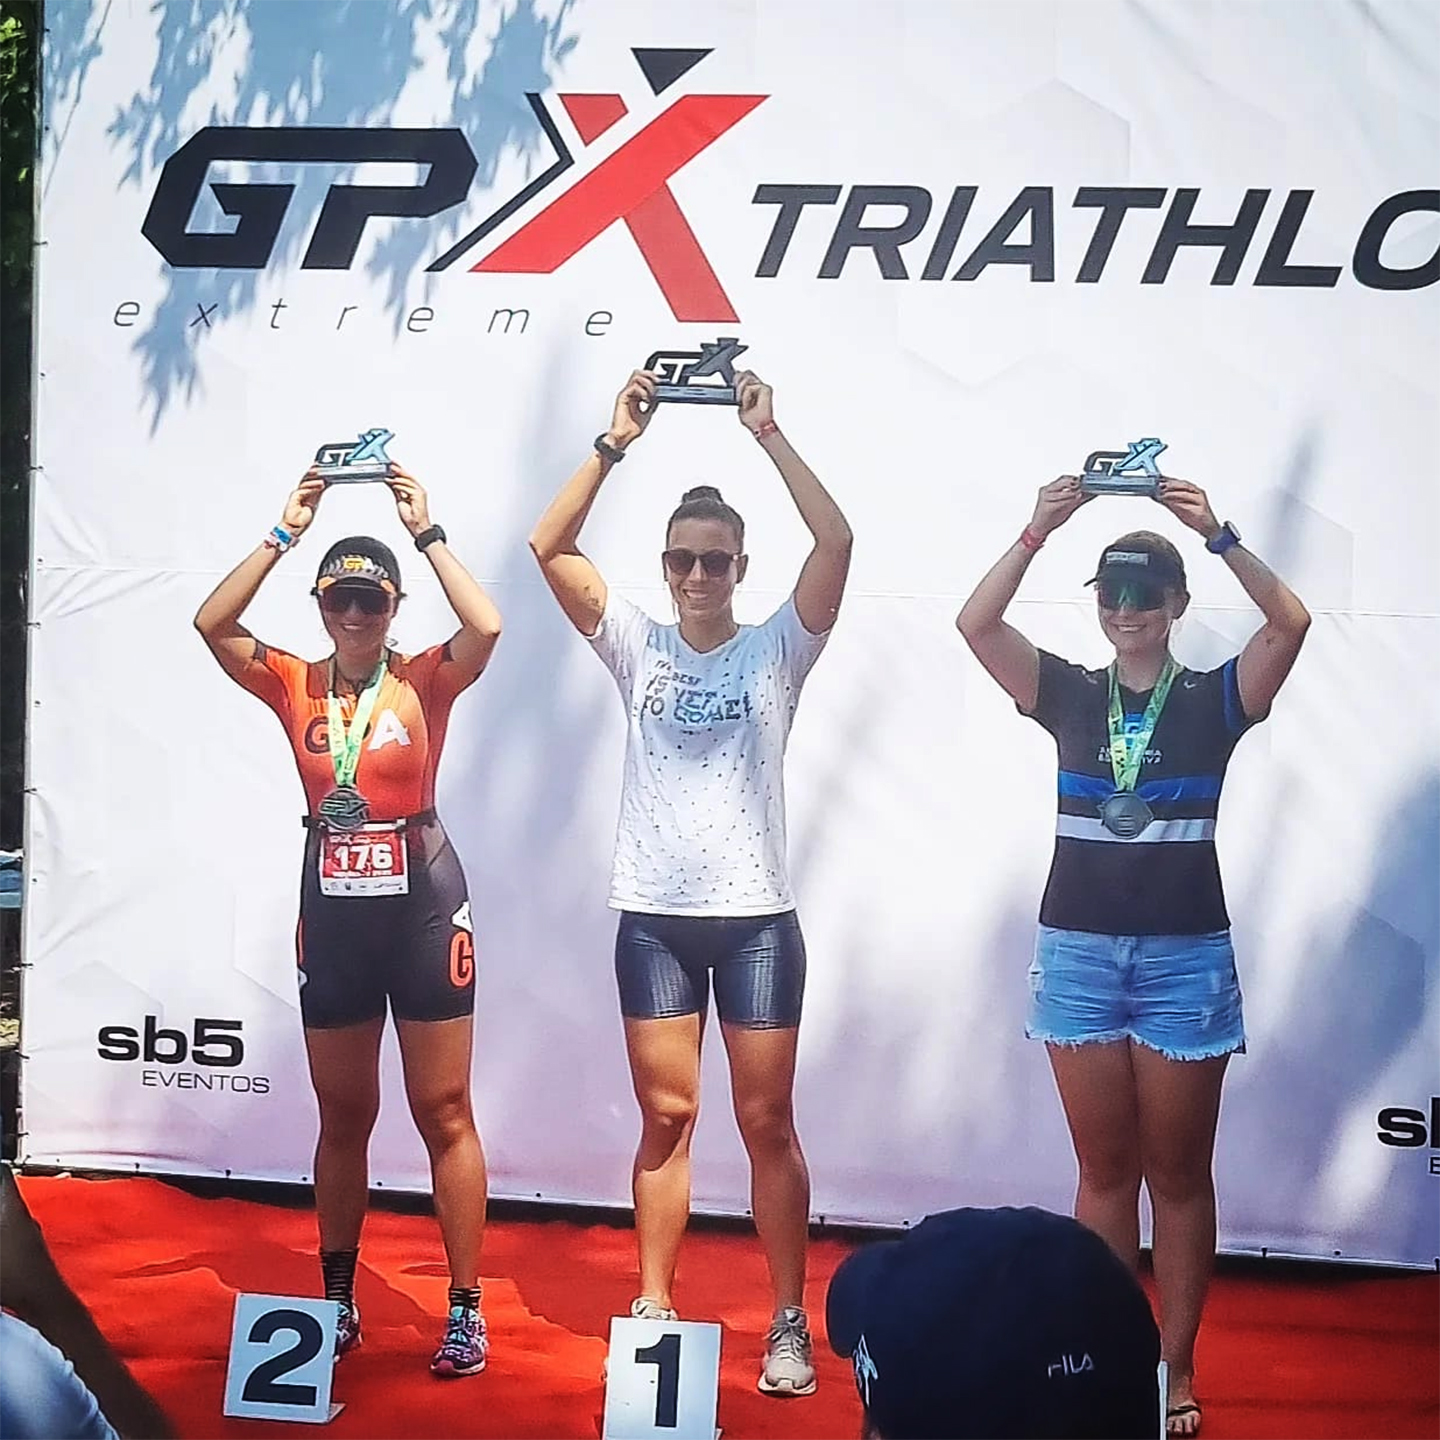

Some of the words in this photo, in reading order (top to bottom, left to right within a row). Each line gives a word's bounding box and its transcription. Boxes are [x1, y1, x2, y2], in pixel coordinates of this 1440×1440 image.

[113, 296, 613, 337] extreme
[334, 843, 394, 871] 176
[97, 1015, 244, 1067] sb5
[142, 1070, 270, 1094] EVENTOS
[241, 1309, 324, 1406] 2
[634, 1333, 682, 1428] 1
